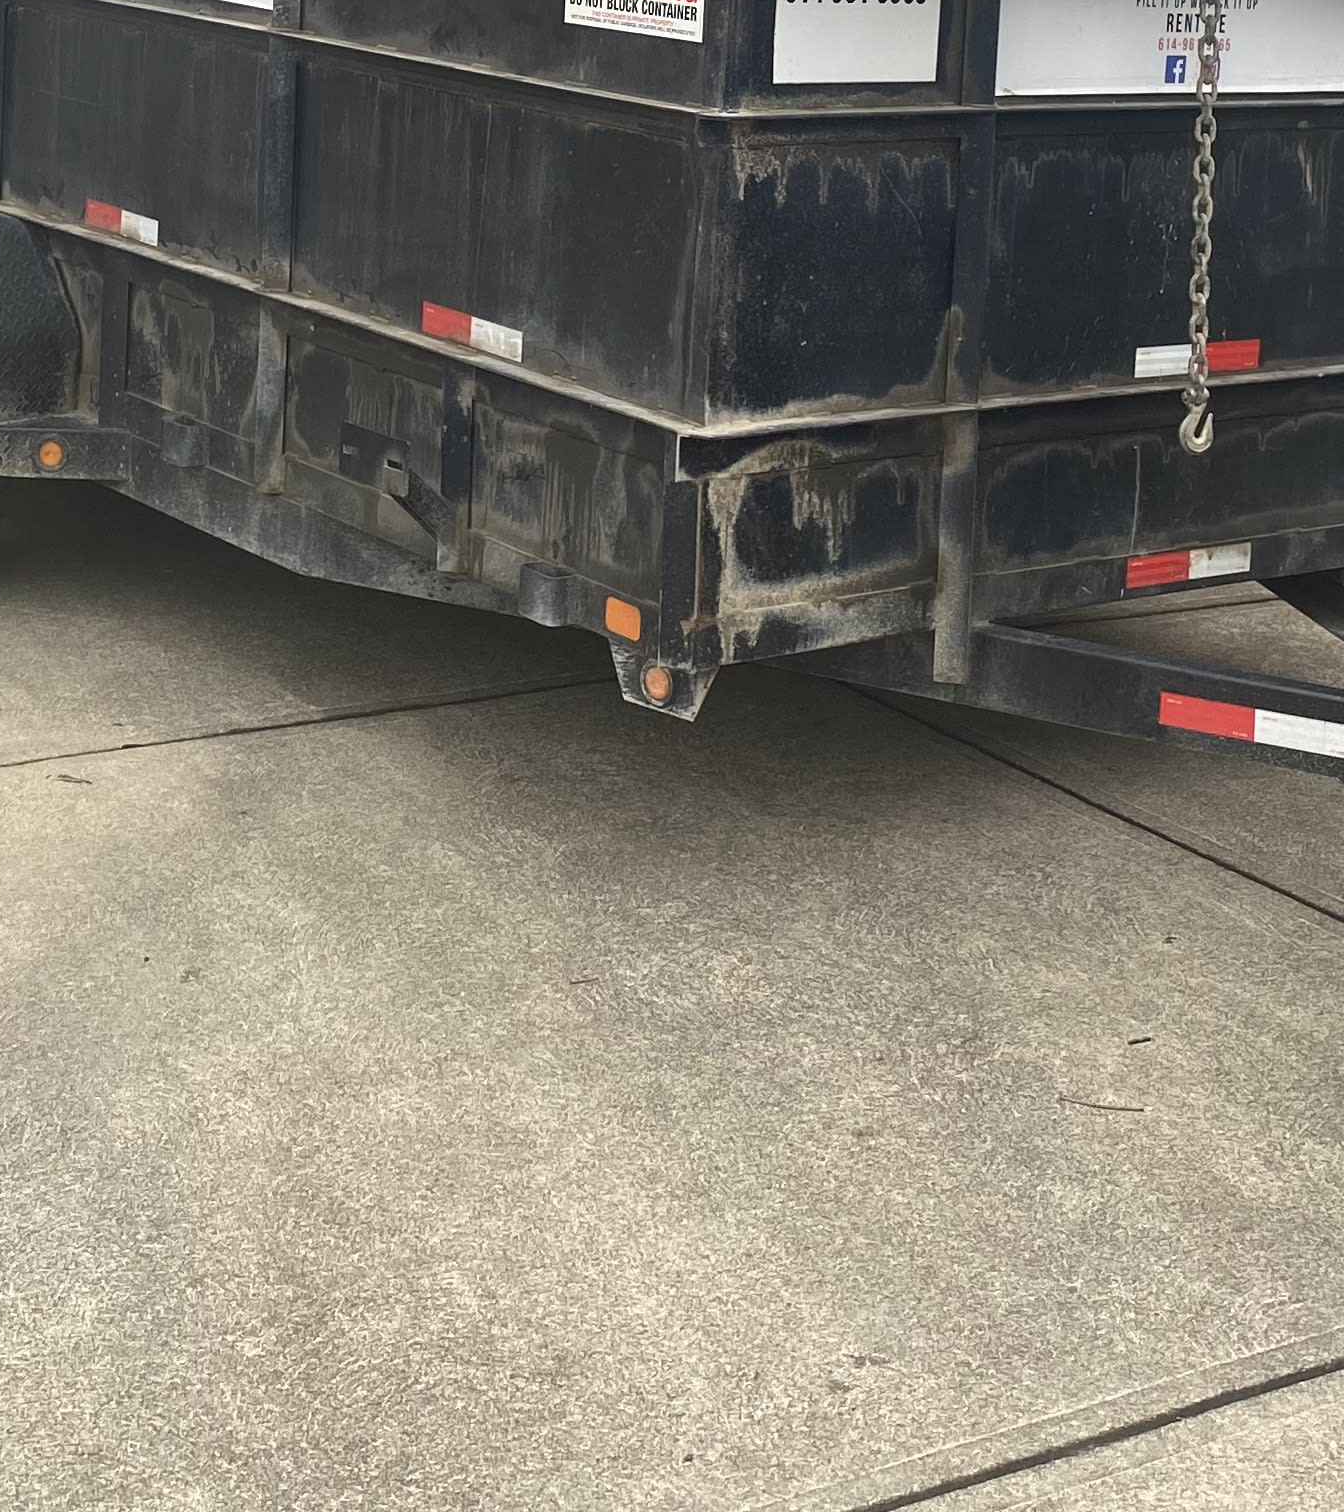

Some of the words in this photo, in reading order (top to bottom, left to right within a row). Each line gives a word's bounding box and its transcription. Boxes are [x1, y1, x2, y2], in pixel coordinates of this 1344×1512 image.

[641, 0, 698, 22] CONTAINER
[1166, 13, 1201, 33] RENT
[1158, 37, 1231, 52] 614-9665
